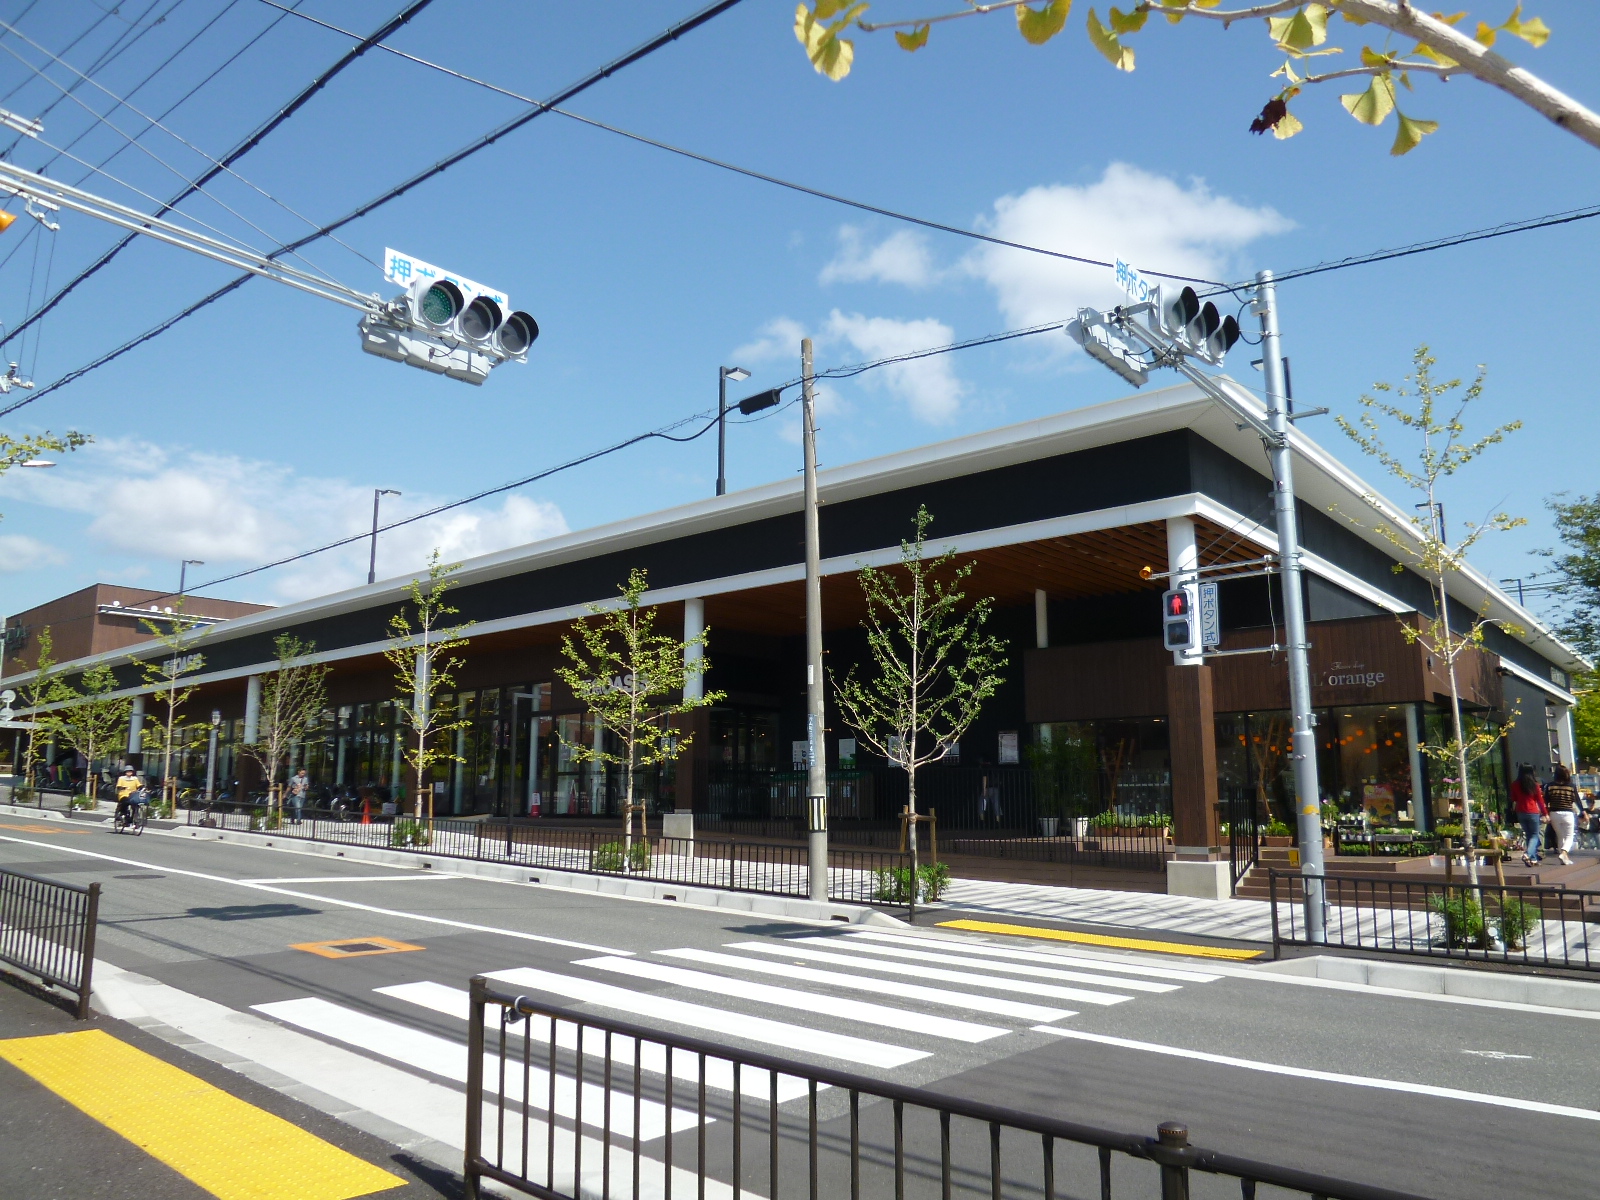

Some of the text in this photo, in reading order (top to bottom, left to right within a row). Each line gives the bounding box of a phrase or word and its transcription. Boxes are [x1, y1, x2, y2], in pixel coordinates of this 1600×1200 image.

[1203, 587, 1216, 642] 押ボタン式
